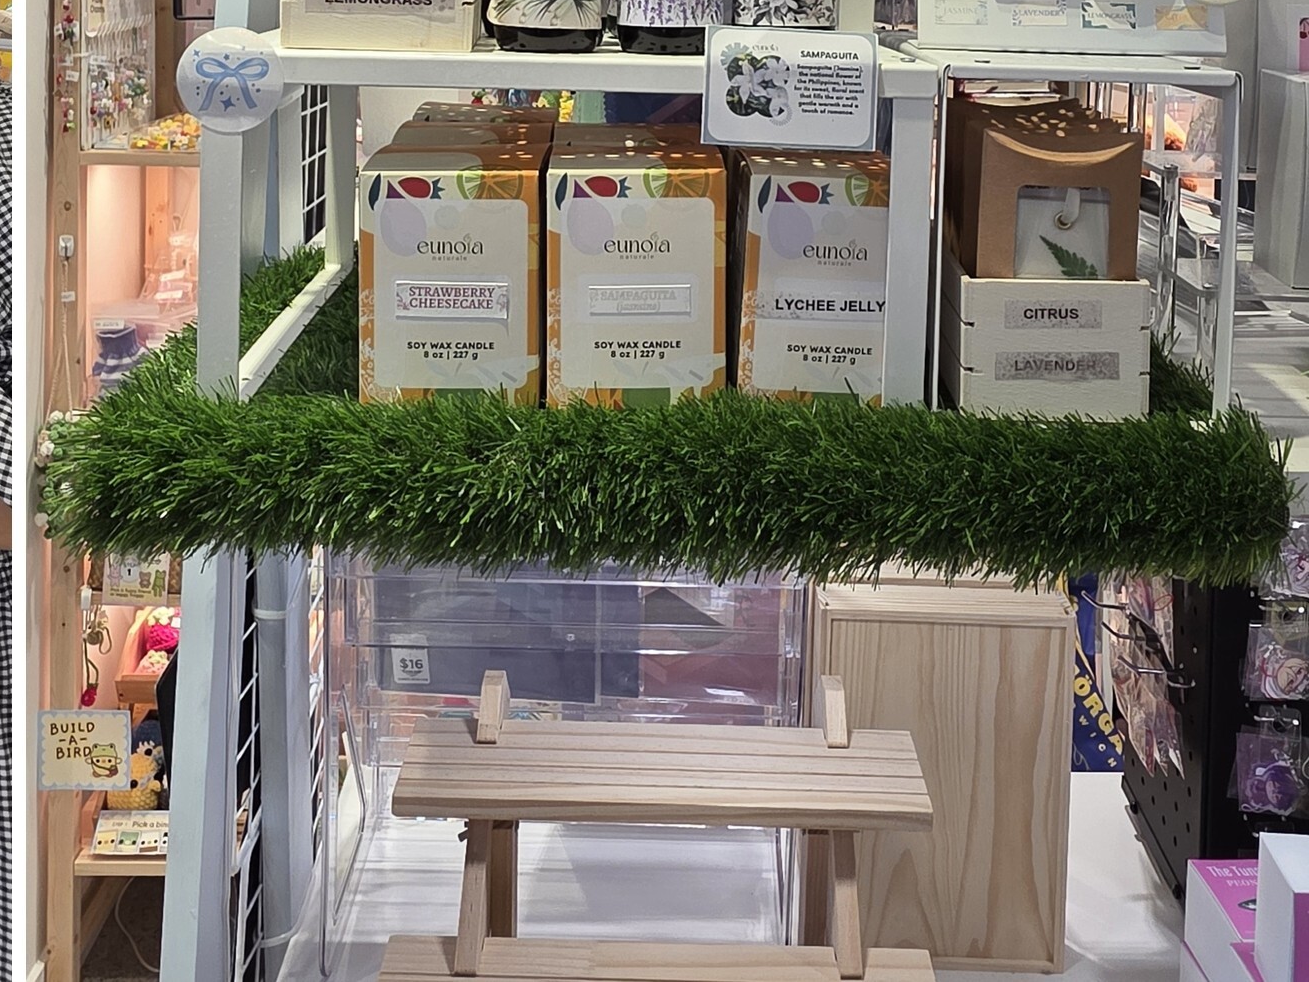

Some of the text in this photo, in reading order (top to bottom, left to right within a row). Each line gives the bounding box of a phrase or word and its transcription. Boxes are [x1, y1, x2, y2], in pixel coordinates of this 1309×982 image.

[800, 50, 859, 60] SAMPAGUITA
[417, 233, 483, 254] eunoia
[604, 231, 670, 253] eunoia
[803, 239, 868, 261] eunoia
[409, 286, 496, 298] STRAWBERRY
[409, 298, 493, 310] CHEESECAKE
[775, 298, 886, 313] LYCHEE JELLY
[1023, 308, 1079, 320] CITRUS
[642, 341, 681, 349] CANDLE
[787, 344, 872, 355] SOY WAX CANDLE
[424, 351, 429, 359] 8
[453, 351, 469, 359] 227
[472, 352, 478, 361] g
[611, 350, 616, 358] 8
[640, 350, 656, 358] 227
[659, 351, 665, 359] g
[1014, 359, 1097, 372] LAVENDER
[400, 658, 423, 669] $16
[50, 722, 95, 736] BUILD
[56, 746, 91, 760] BIRD
[132, 820, 148, 828] Pick
[1207, 866, 1231, 878] The
